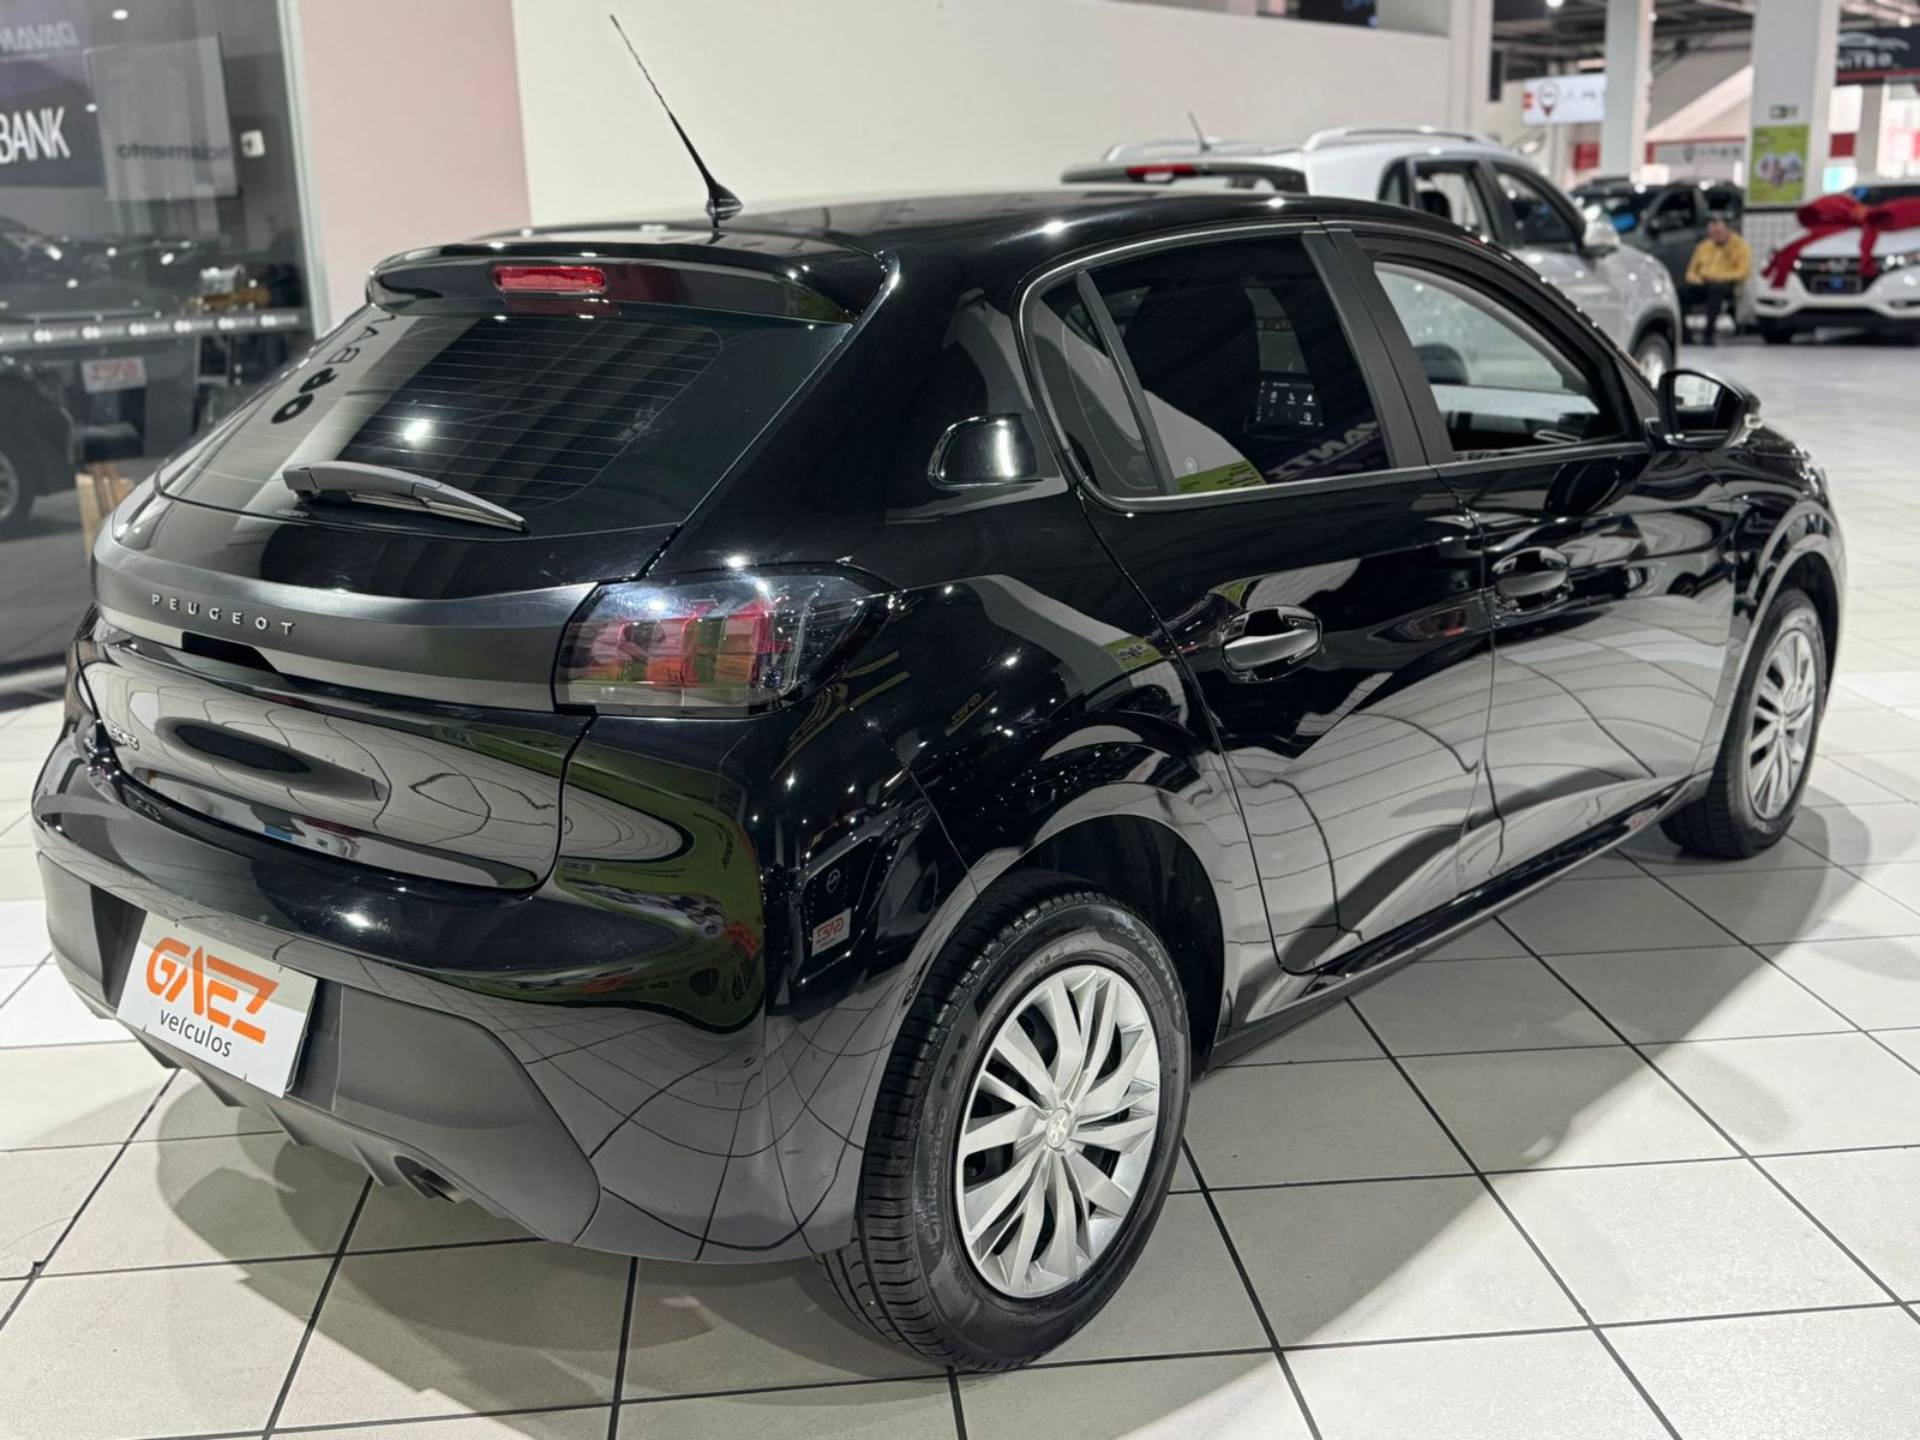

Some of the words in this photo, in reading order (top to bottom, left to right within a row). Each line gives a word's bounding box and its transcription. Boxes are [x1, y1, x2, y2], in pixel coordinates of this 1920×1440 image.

[151, 594, 296, 636] PEUGEOT
[145, 936, 280, 1044] GAEZ
[160, 1009, 233, 1058] veículos
